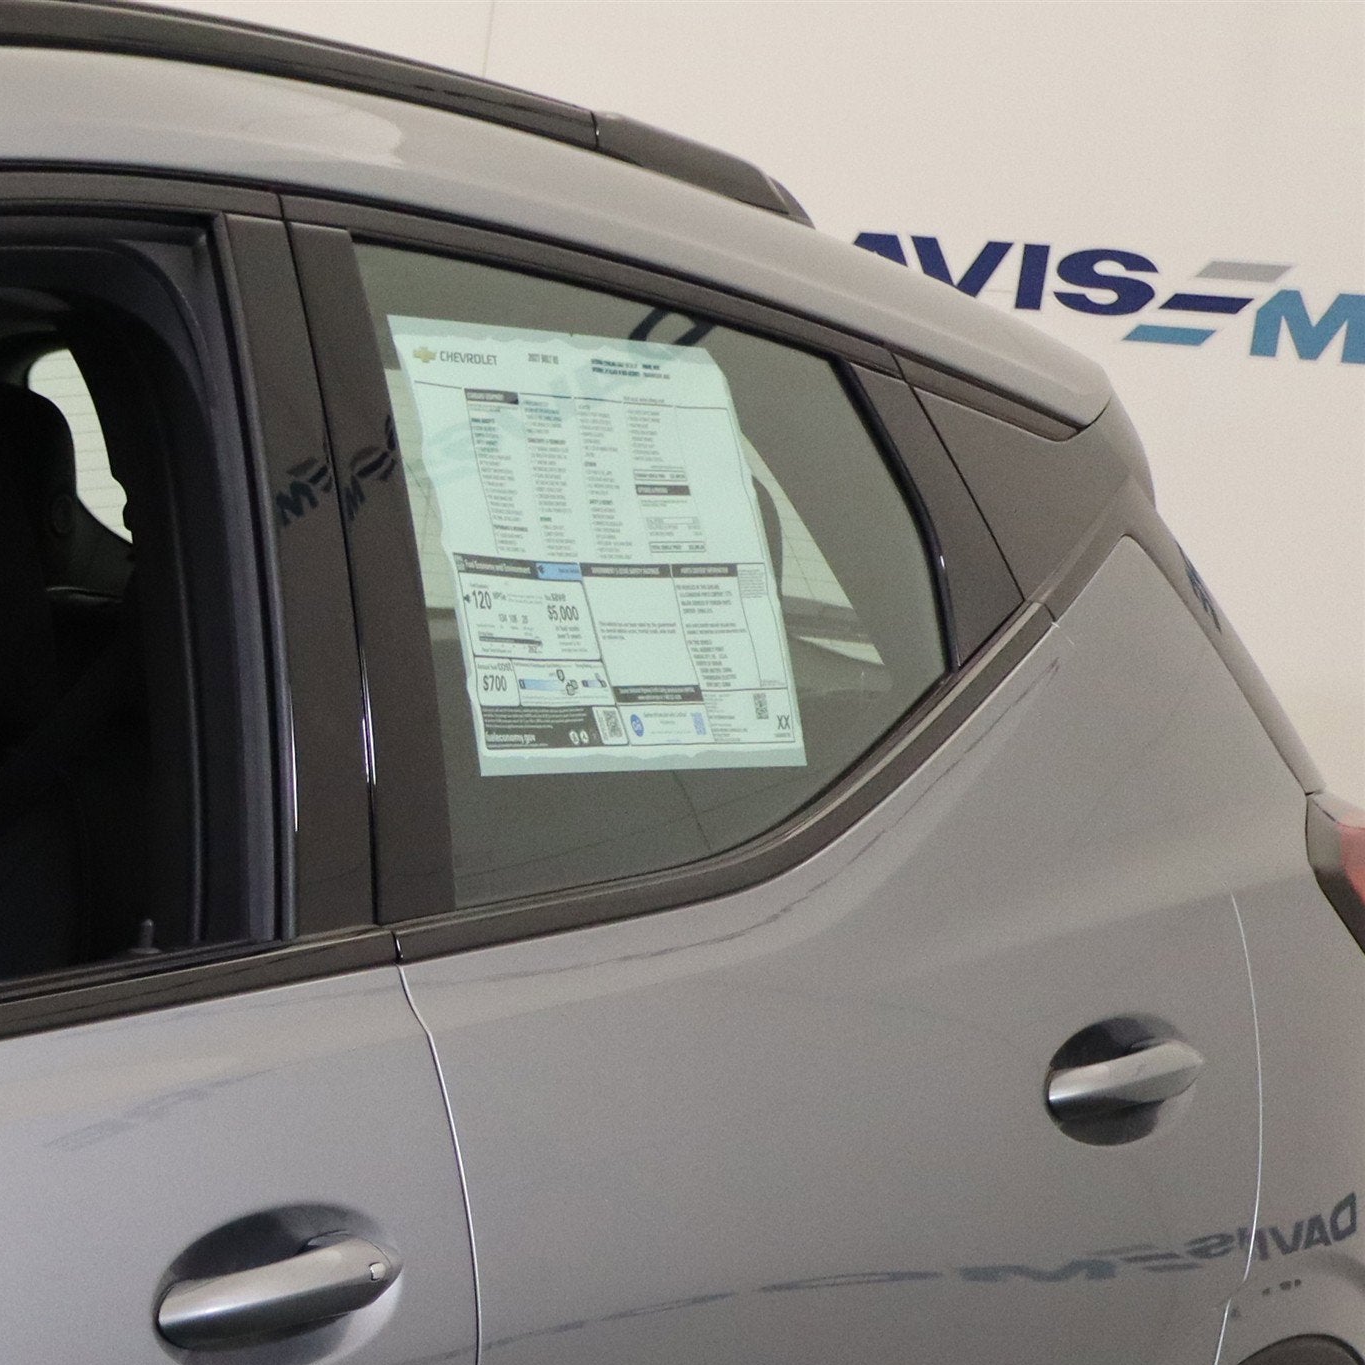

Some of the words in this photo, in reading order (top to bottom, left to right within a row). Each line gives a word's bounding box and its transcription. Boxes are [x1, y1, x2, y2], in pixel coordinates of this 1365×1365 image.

[853, 231, 1161, 316] VIS
[439, 350, 499, 367] CHEVROLET
[472, 590, 493, 610] 120
[547, 605, 580, 622] $5,000
[483, 674, 508, 692] $700
